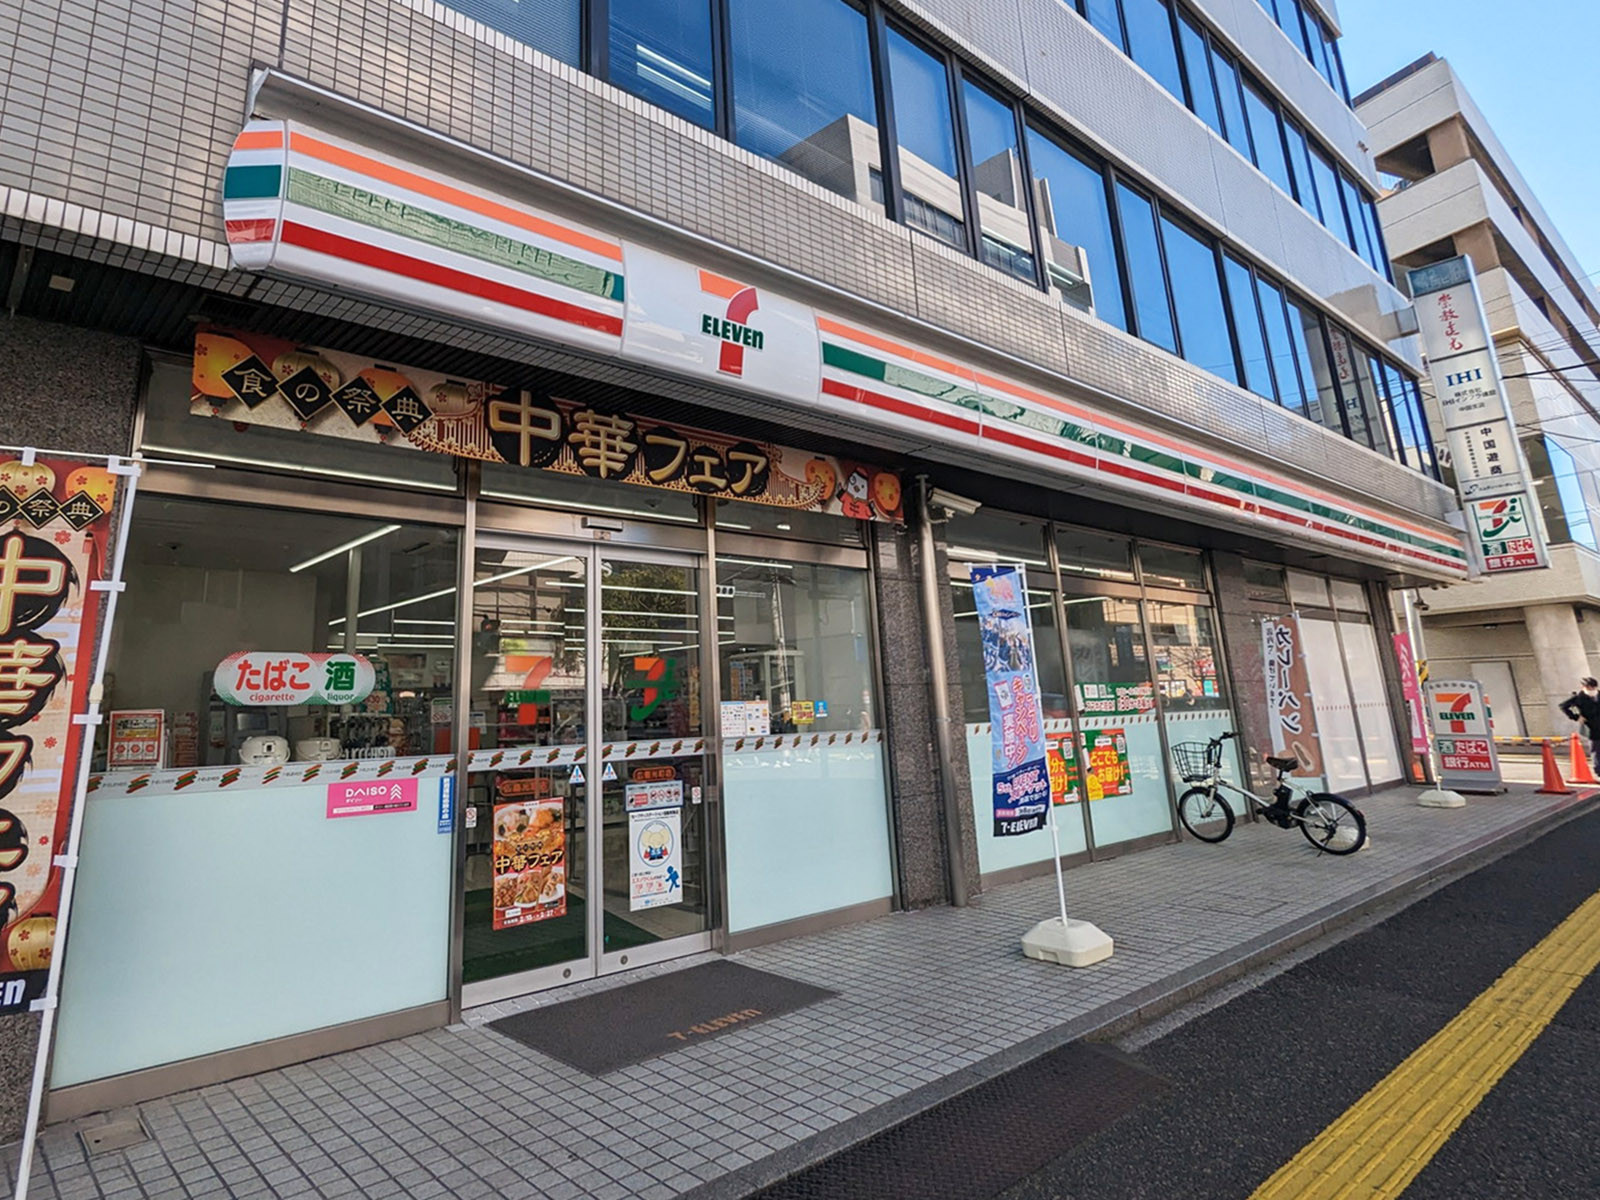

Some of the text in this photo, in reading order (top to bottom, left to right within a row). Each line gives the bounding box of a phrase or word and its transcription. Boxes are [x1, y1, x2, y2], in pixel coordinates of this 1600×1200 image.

[1445, 368, 1483, 387] IHI
[233, 367, 424, 424] 食の祭典
[489, 389, 770, 494] 中華フェア
[235, 659, 311, 692] たばこ
[324, 660, 357, 691] 酒
[249, 692, 296, 702] cigarette
[326, 692, 355, 702] liquor
[1012, 676, 1028, 764] キャンペーン
[1439, 740, 1455, 755] 酒
[1455, 739, 1489, 755] たばこ
[1090, 750, 1118, 766] どこでも
[1444, 755, 1490, 770] 銀行ATM
[1098, 765, 1125, 783] お届け!
[345, 786, 387, 797] DAISO
[495, 849, 564, 875] 中華フェア
